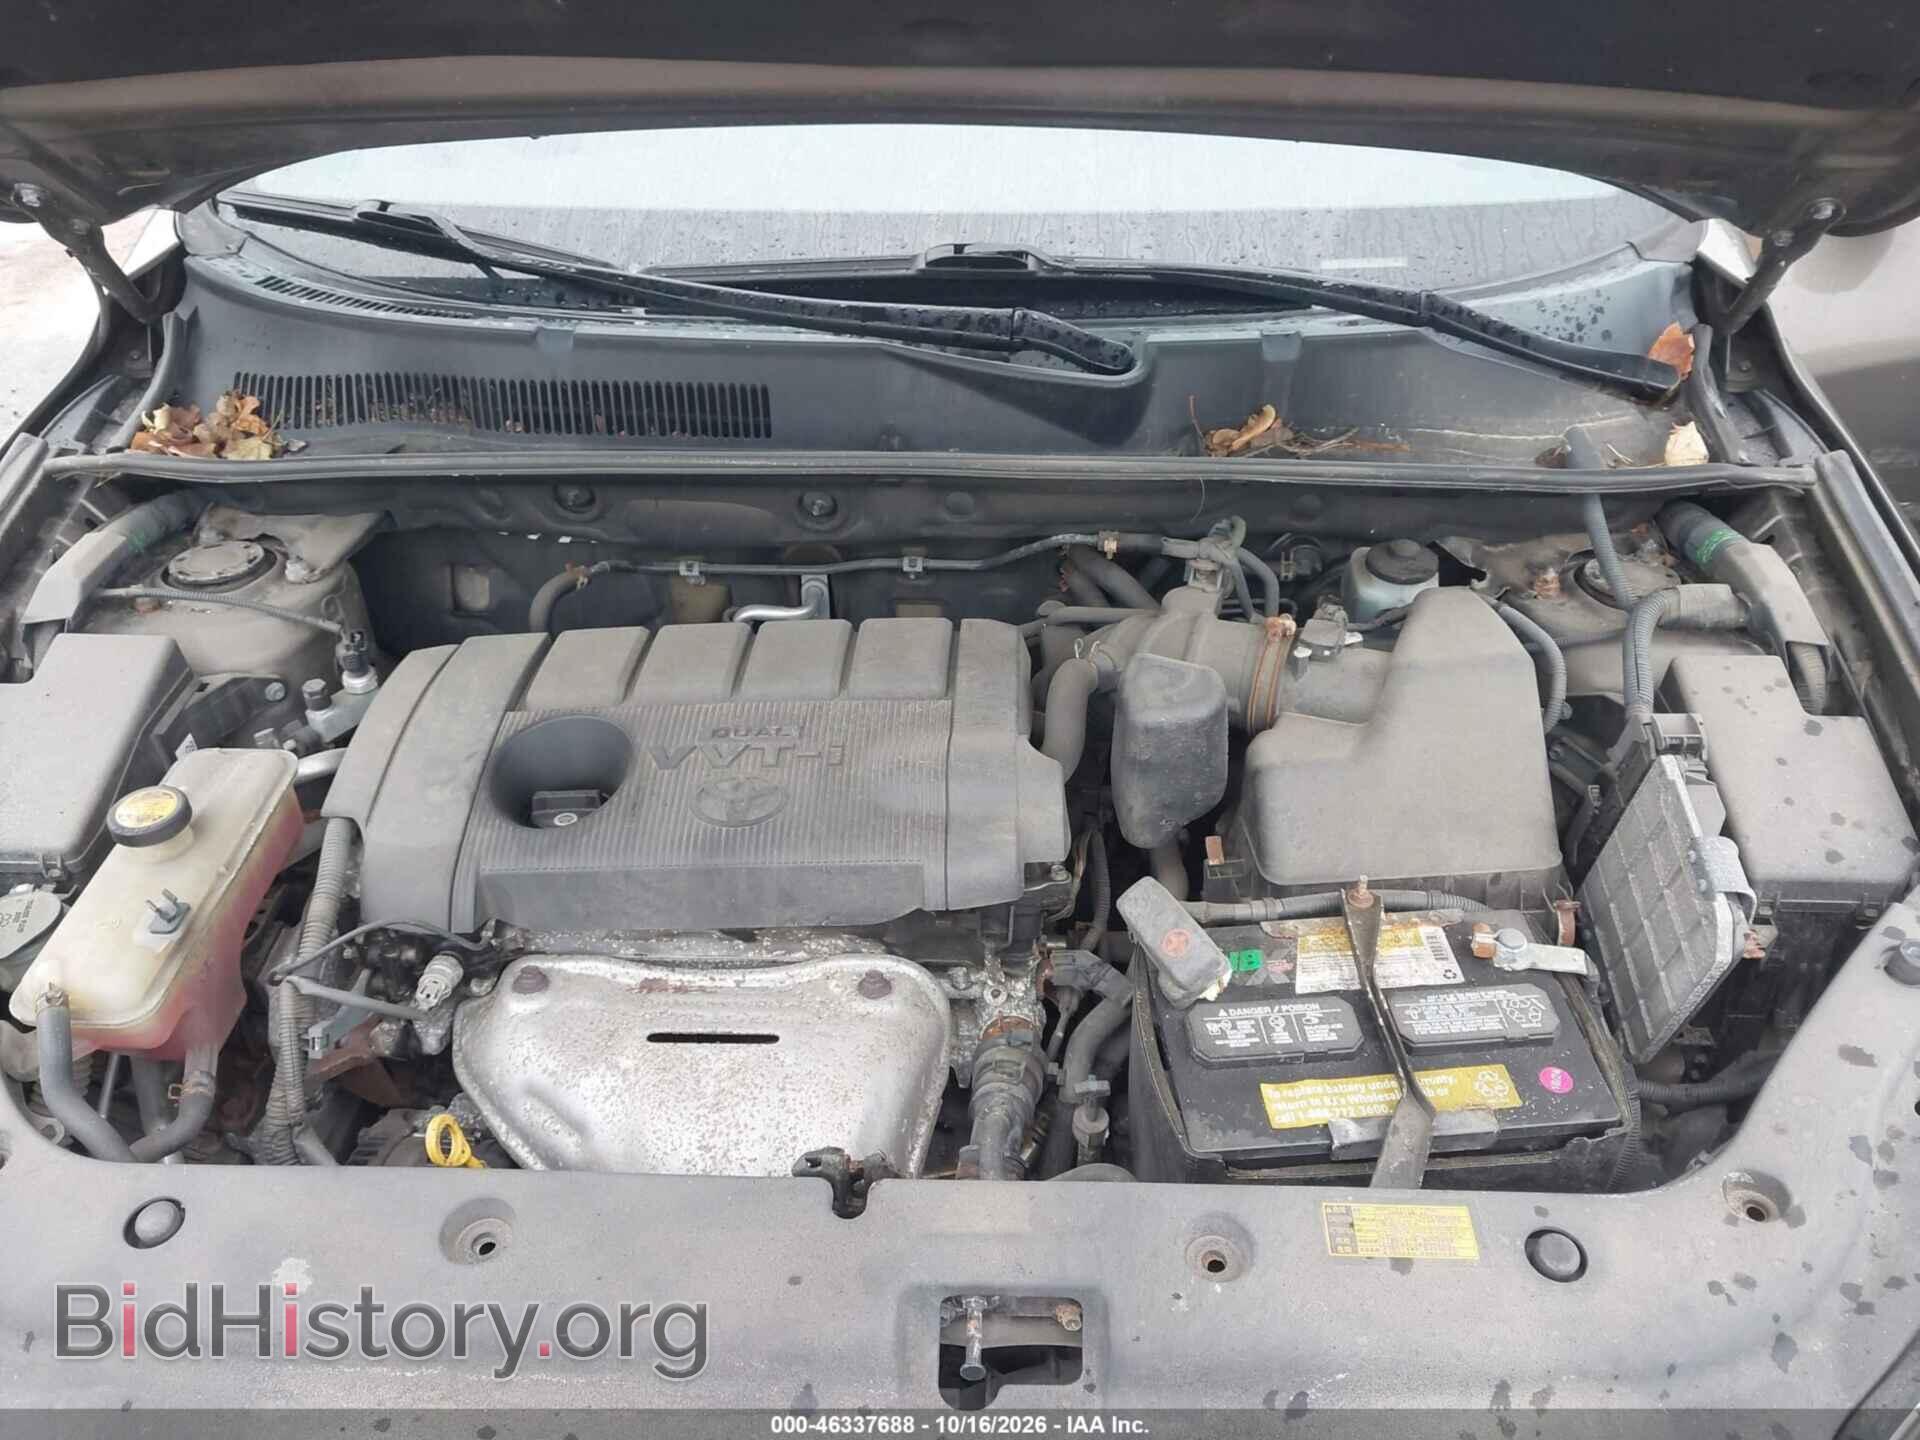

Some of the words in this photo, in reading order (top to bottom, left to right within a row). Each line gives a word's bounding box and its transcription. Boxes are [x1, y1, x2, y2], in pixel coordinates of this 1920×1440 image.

[709, 726, 795, 739] DUAL
[1228, 1006, 1272, 1017] DANGER
[1281, 1002, 1320, 1013] POISON
[1326, 1083, 1366, 1095] battery
